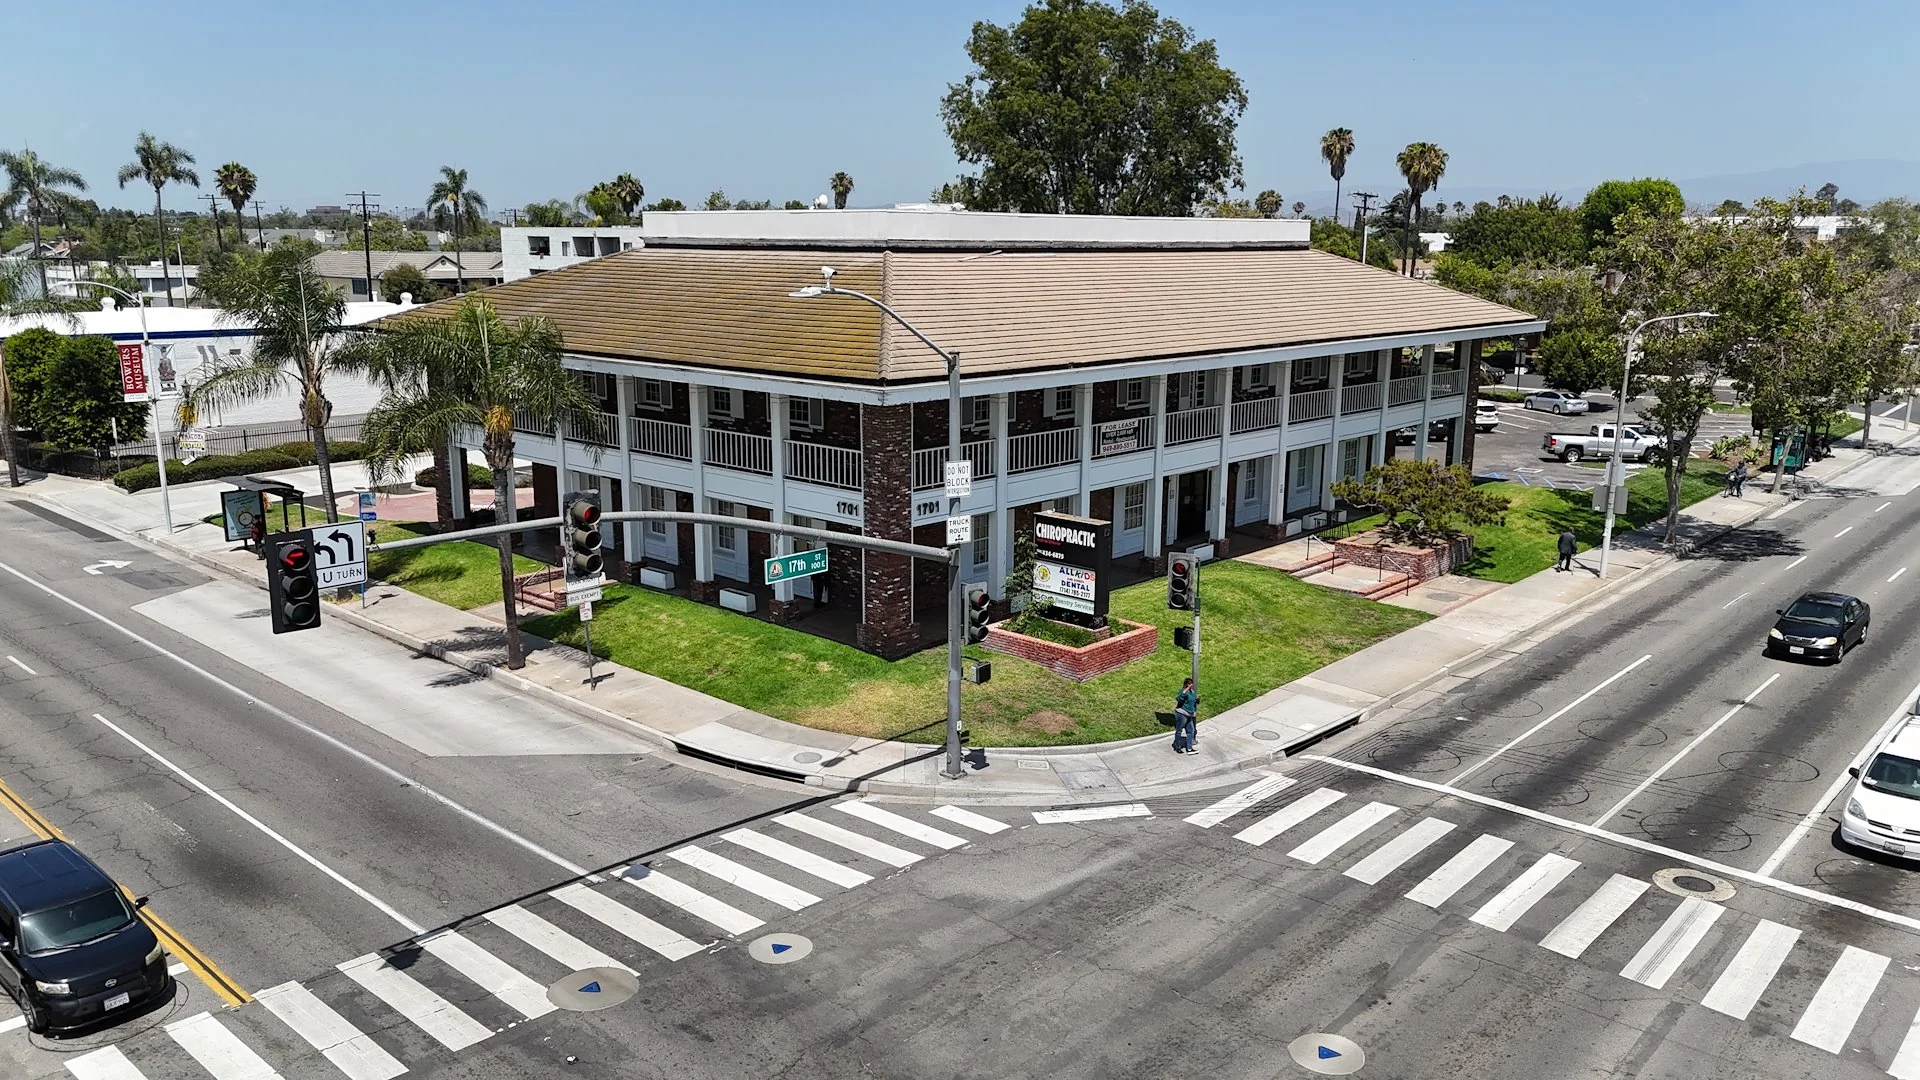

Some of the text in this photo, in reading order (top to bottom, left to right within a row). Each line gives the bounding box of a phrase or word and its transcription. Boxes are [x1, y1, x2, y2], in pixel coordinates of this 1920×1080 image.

[122, 348, 134, 390] BOWERS
[131, 347, 143, 389] MUSEUM
[947, 464, 969, 476] DO NOT
[946, 477, 970, 487] BLOCK
[837, 501, 859, 516] 1701
[917, 501, 940, 516] 1701
[949, 518, 970, 526] TRUCK
[949, 526, 969, 535] ROUTE
[1036, 523, 1095, 548] CHIROPRACTIC
[814, 553, 822, 561] ST
[789, 559, 806, 573] 17th
[810, 562, 821, 570] 100
[323, 568, 362, 583] U TURN
[1061, 580, 1090, 591] DENTAL
[581, 591, 600, 599] EXEMPT
